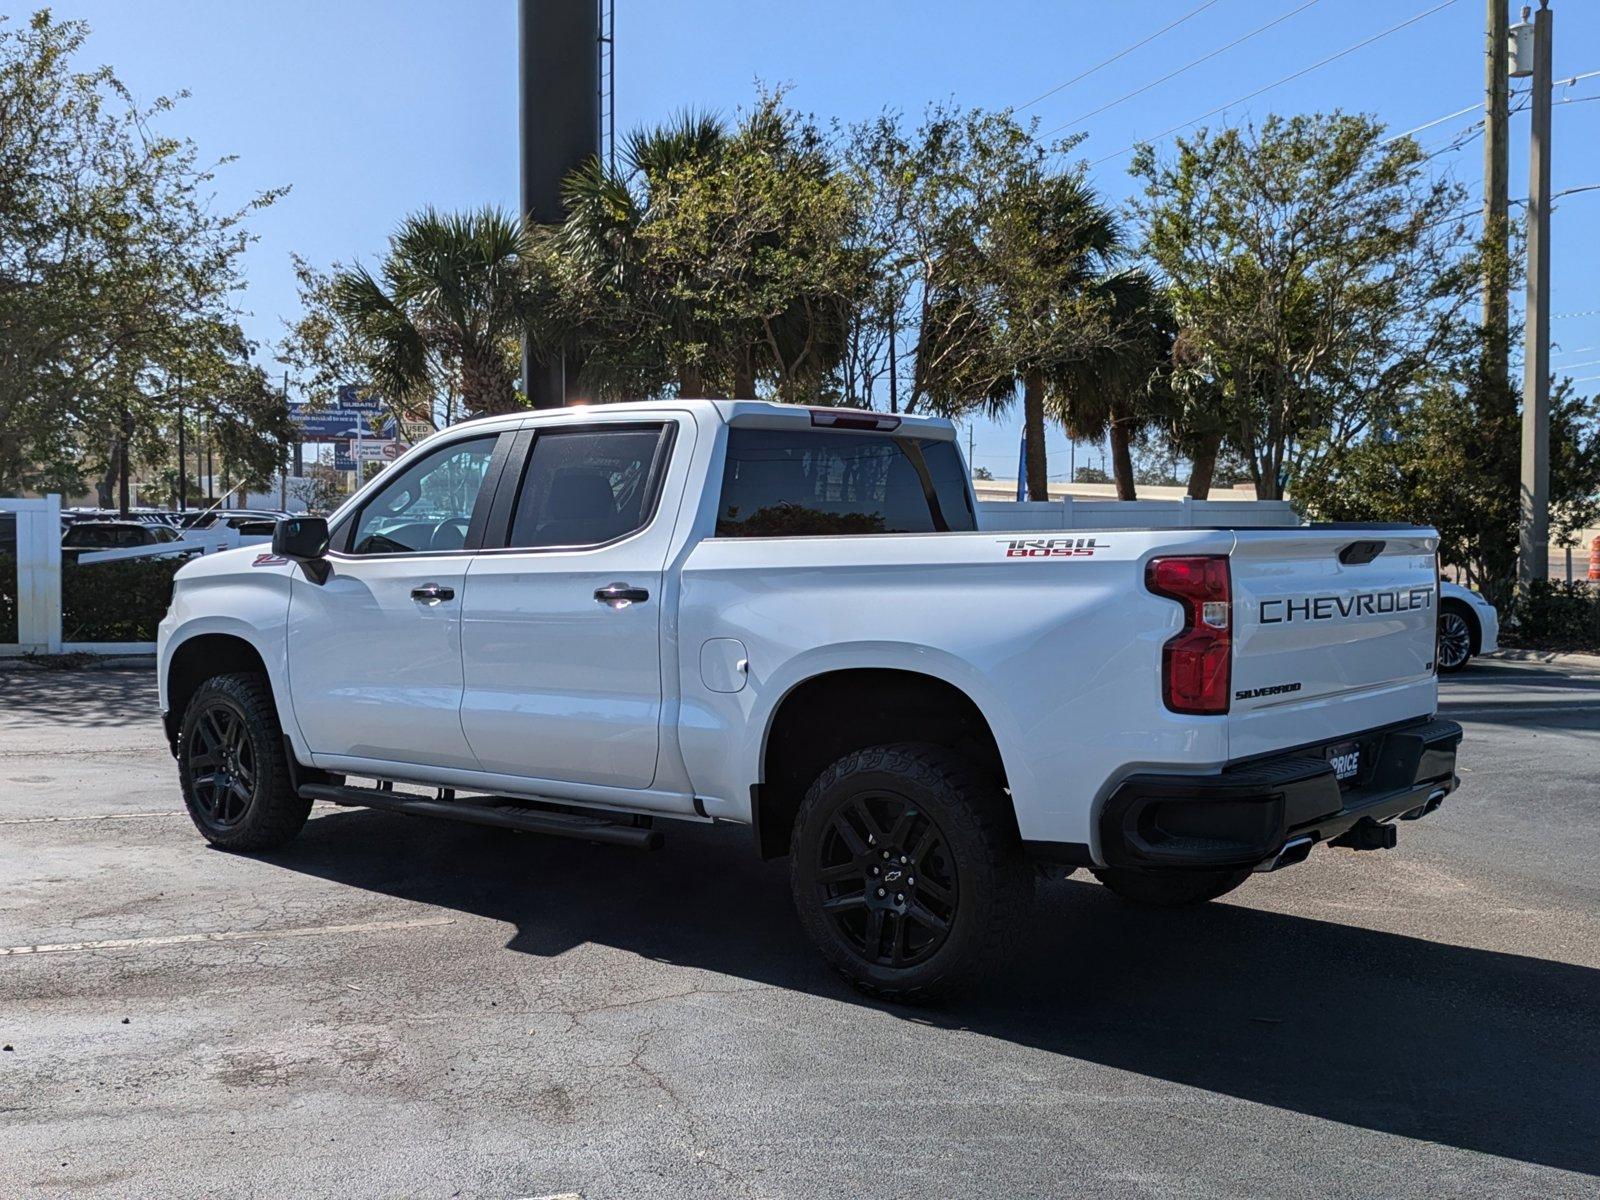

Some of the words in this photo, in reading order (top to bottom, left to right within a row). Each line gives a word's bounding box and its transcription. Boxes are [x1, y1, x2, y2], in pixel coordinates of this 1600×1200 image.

[996, 538, 1111, 549] TRAIL
[1006, 548, 1094, 557] BOSS
[1259, 588, 1434, 624] CHEVROLET
[1235, 682, 1302, 701] SILVERADO
